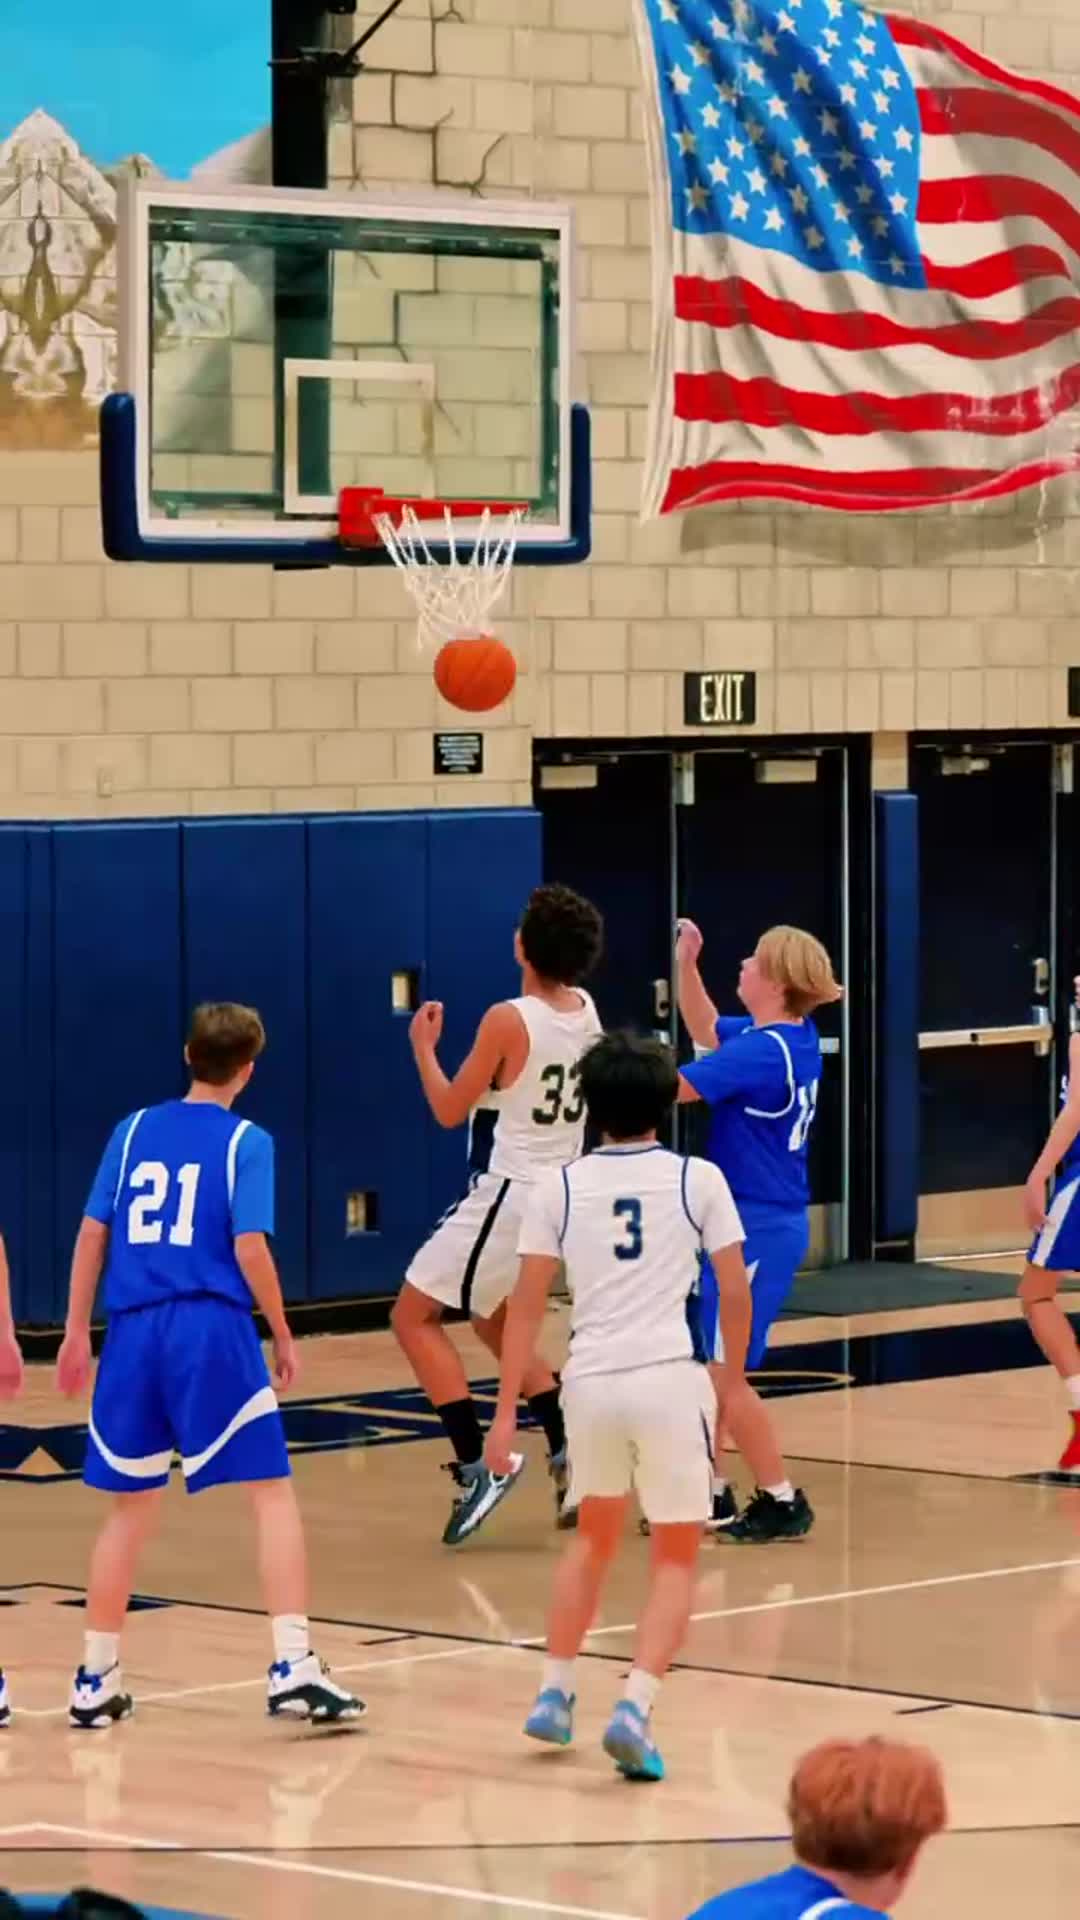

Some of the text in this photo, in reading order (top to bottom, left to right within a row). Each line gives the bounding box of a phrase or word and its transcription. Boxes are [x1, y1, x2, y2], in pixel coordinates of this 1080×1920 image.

[700, 674, 744, 722] EXIT
[532, 1063, 583, 1125] 33
[128, 1161, 200, 1247] 21
[613, 1197, 643, 1261] 3
